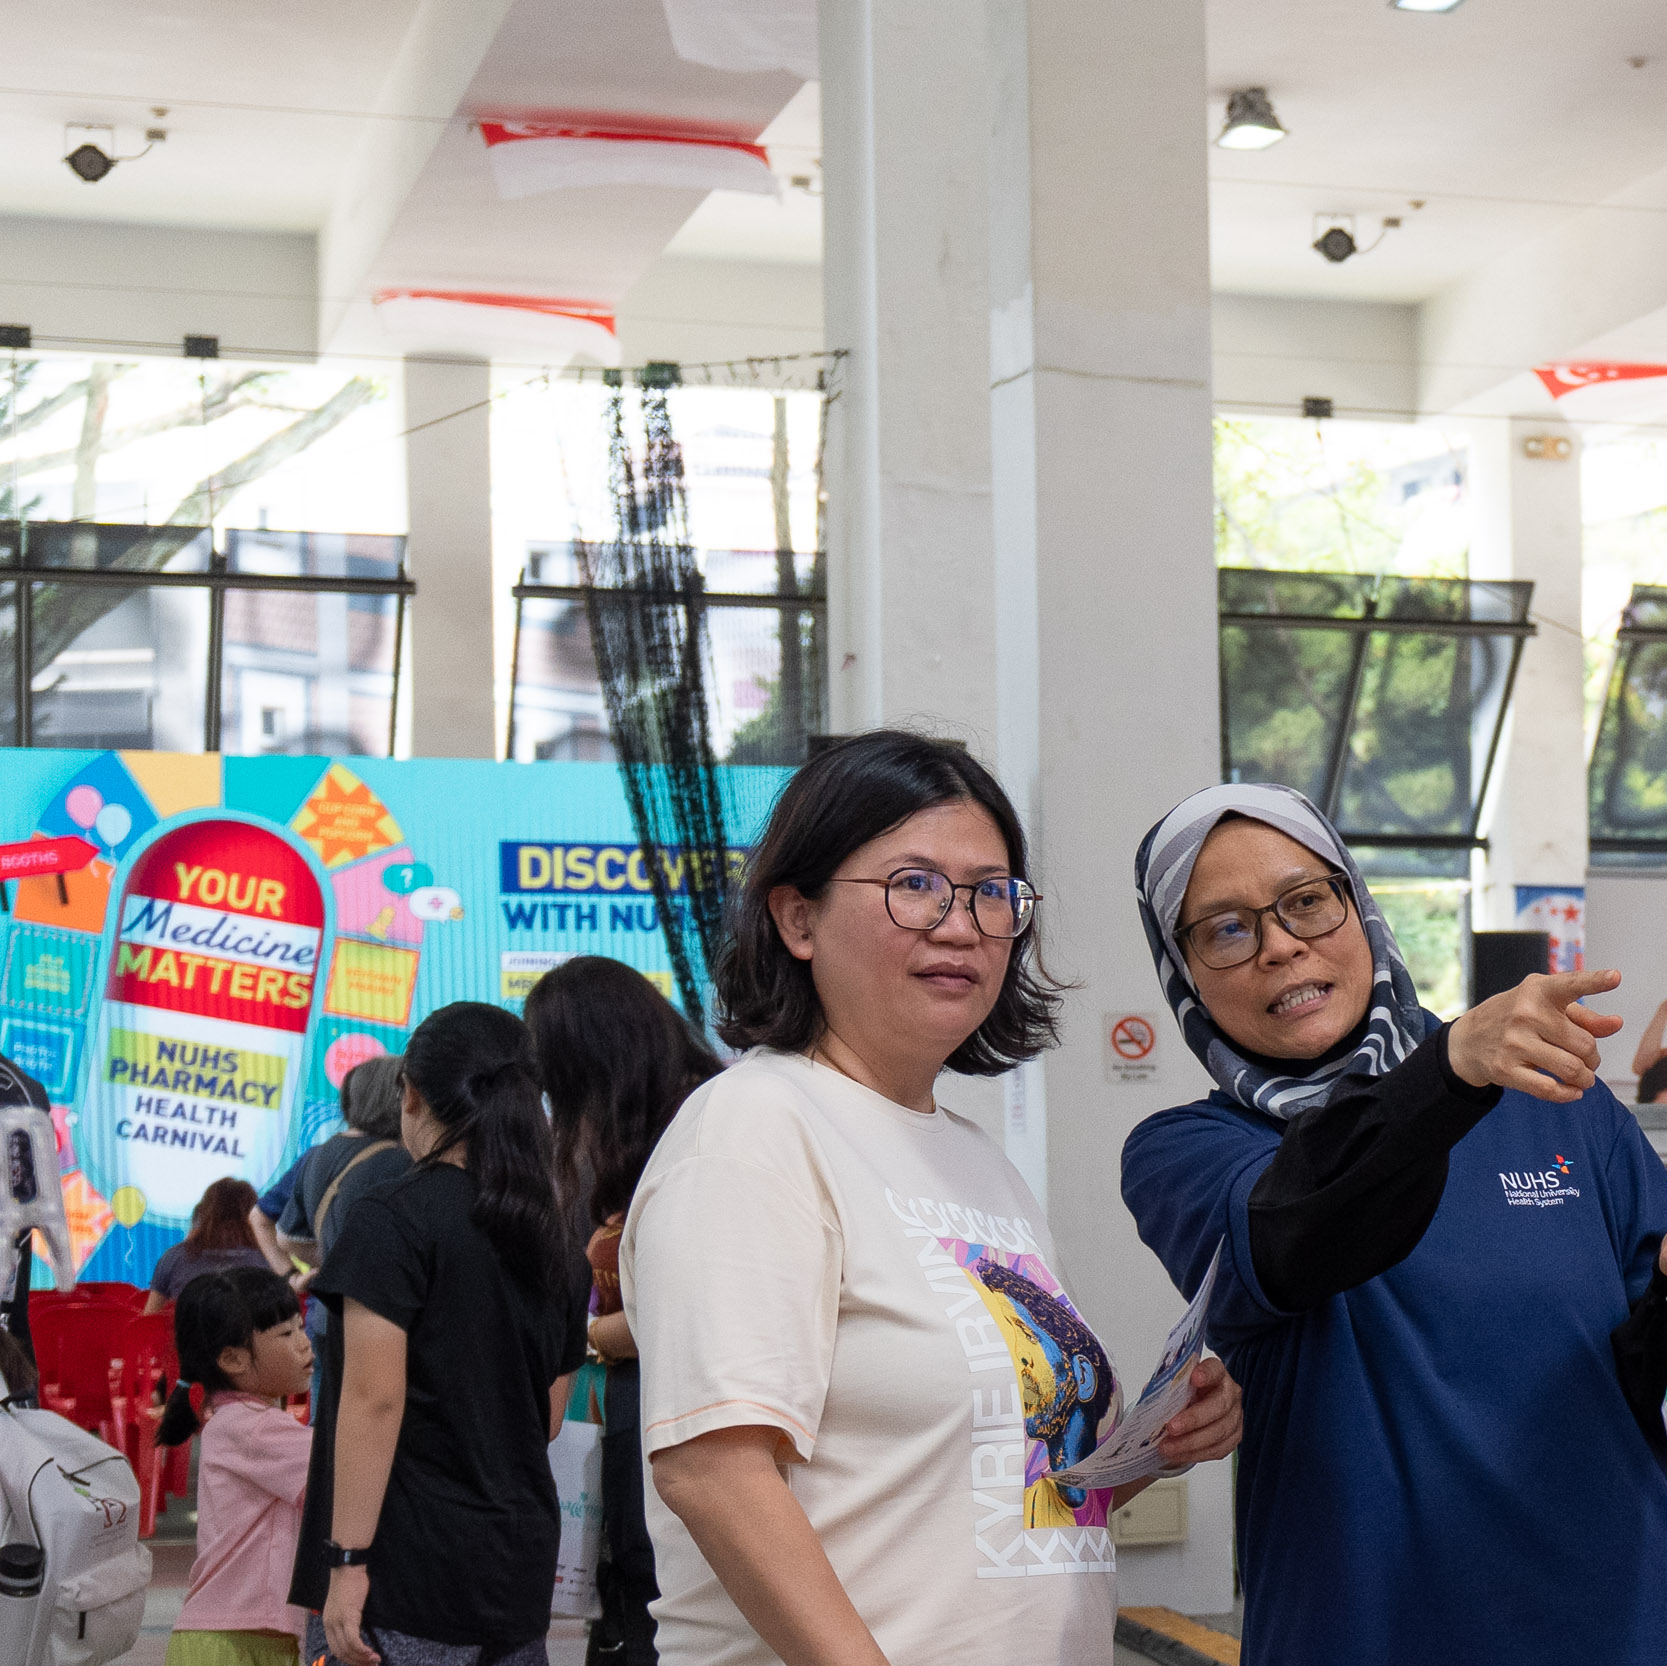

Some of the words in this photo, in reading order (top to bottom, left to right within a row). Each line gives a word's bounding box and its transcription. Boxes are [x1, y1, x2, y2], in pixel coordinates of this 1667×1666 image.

[174, 862, 287, 917] YOUR
[120, 897, 316, 966] Medicine
[501, 903, 598, 931] WITH
[115, 942, 314, 1009] MATTERS
[156, 1041, 238, 1073] NUHS
[109, 1058, 278, 1106] PHARMACY
[135, 1094, 237, 1128] HEALTH
[116, 1120, 244, 1158] CARNIVAL
[1498, 1171, 1560, 1190] NUHS
[1505, 1190, 1539, 1198] National
[1540, 1187, 1580, 1198] University
[1508, 1198, 1535, 1206] Health
[1536, 1198, 1564, 1208] System
